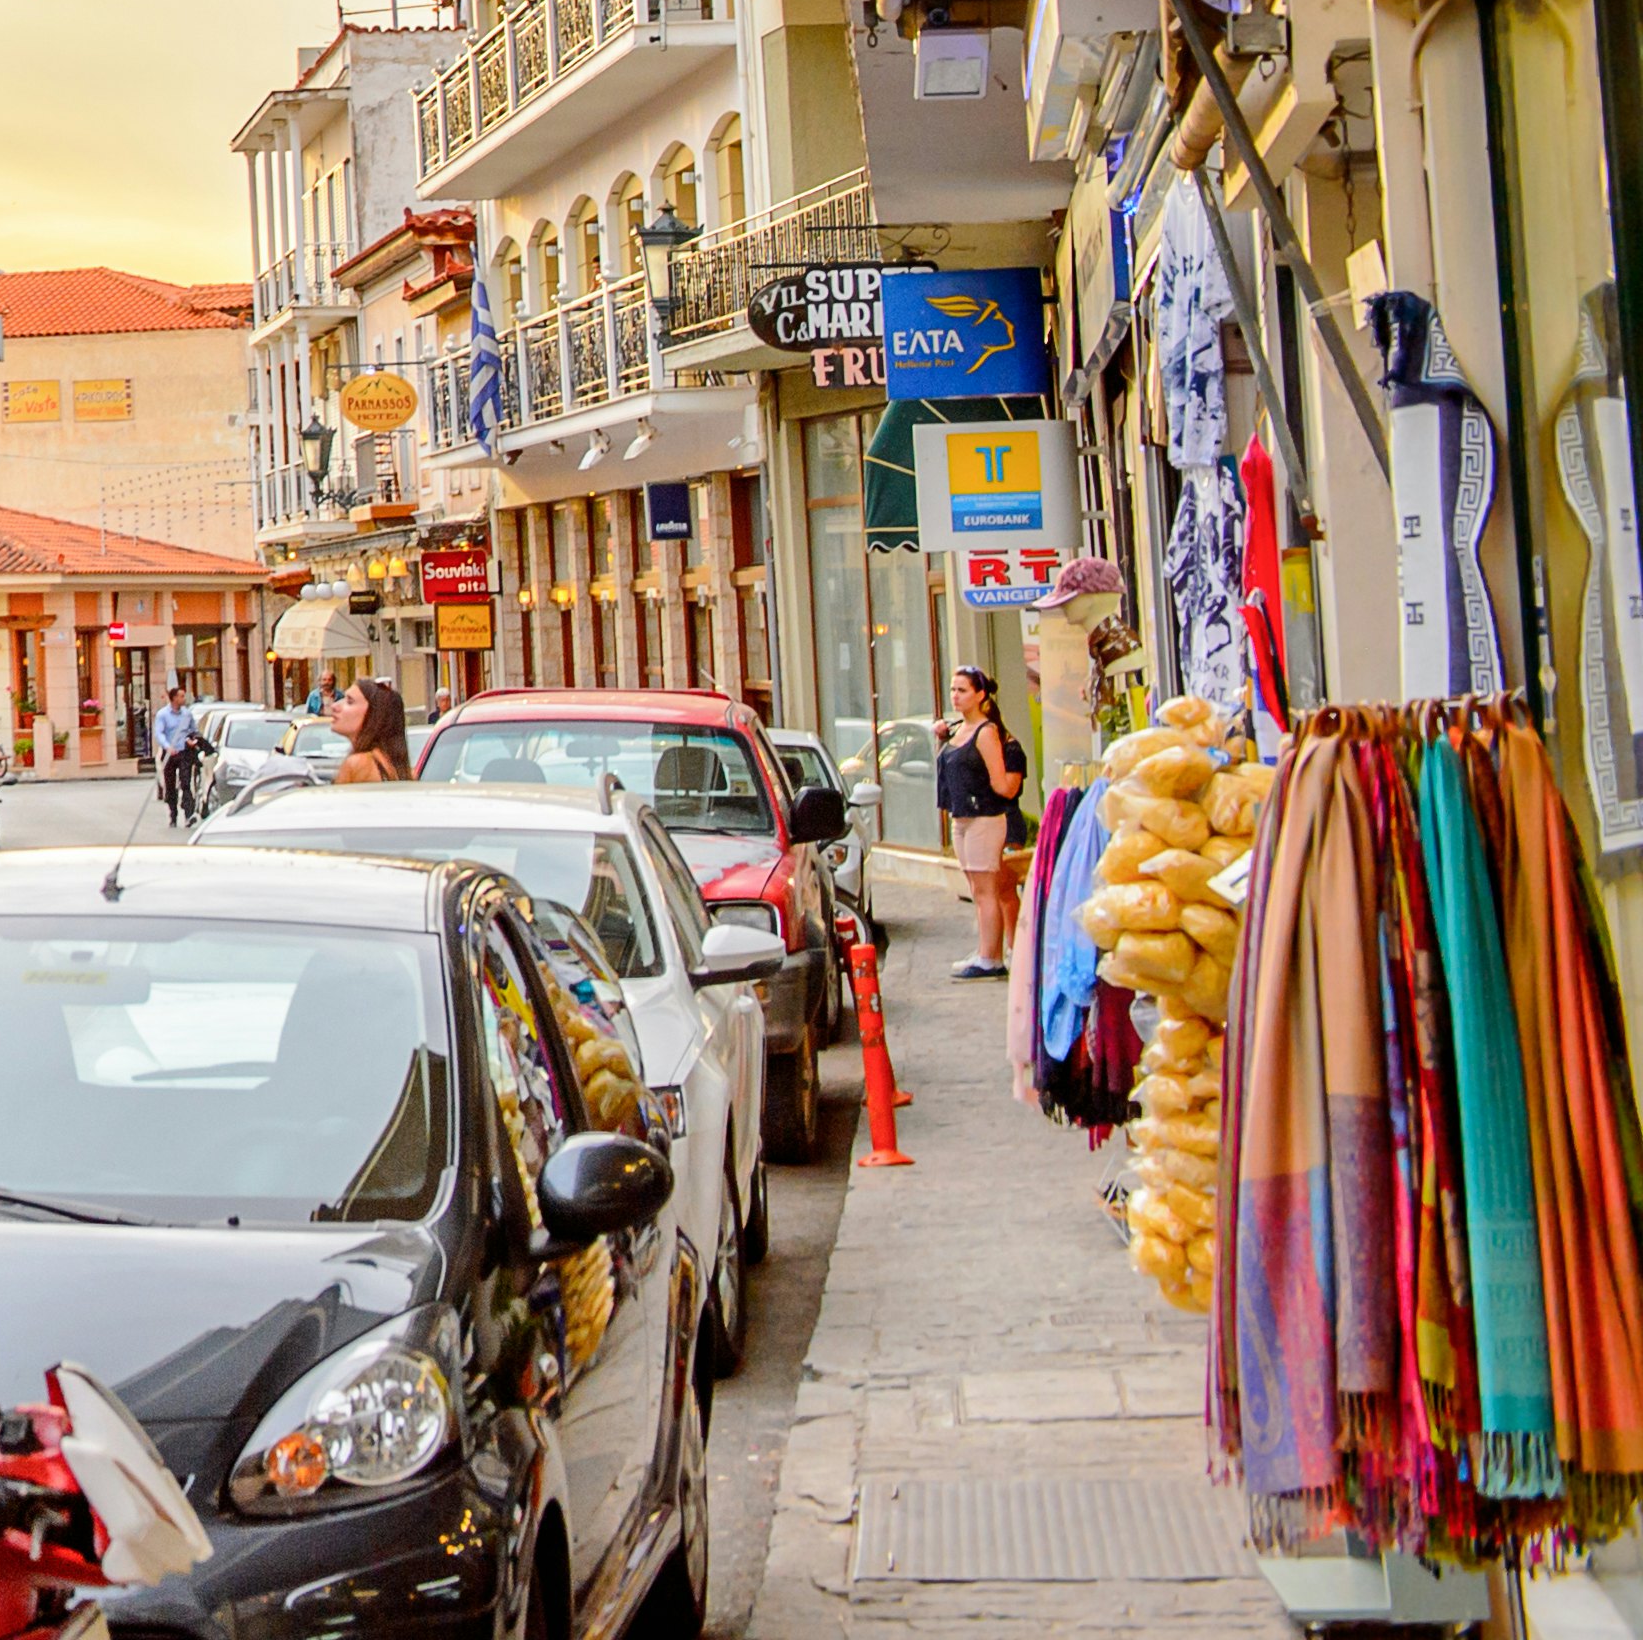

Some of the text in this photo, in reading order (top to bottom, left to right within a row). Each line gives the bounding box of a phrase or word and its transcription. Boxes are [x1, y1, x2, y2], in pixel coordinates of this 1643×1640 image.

[811, 346, 887, 387] FRU
[347, 396, 412, 411] PARNASSOS
[963, 514, 1030, 526] EUROBANK
[424, 562, 485, 580] Souvlaki
[458, 580, 486, 593] pita
